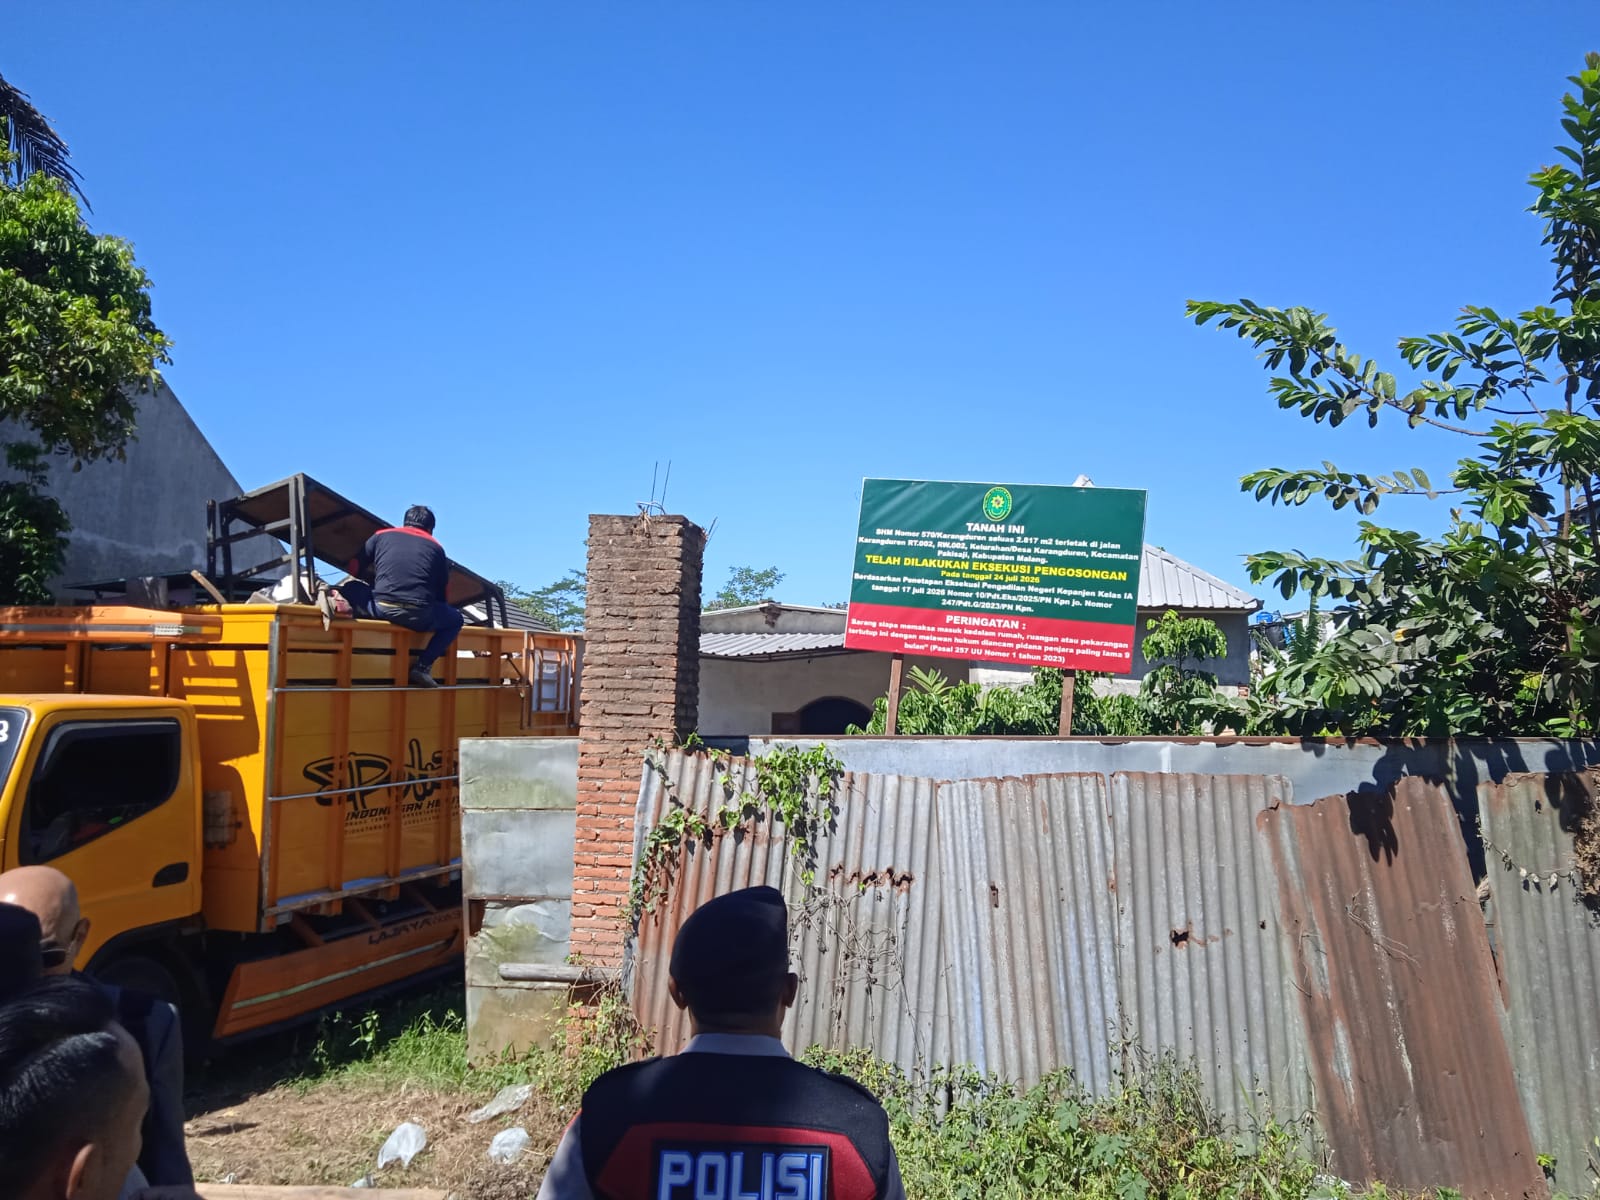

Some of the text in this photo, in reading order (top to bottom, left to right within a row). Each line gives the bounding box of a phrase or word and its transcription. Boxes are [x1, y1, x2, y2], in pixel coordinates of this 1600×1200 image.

[875, 528, 893, 536] SHM
[988, 535, 1014, 543] seluas
[1055, 539, 1087, 547] terletak
[1098, 542, 1121, 550] jalan
[965, 522, 1025, 534] TANAH INI
[858, 537, 906, 546] Karangduren
[907, 540, 935, 548] RT.002,
[970, 543, 1032, 554] Kelurahan/Desa
[1033, 547, 1089, 558] Karangduren,
[1091, 551, 1139, 560] Kecamatan
[971, 551, 1014, 562] Kabupaten
[1016, 555, 1048, 564] Malang.
[865, 554, 1127, 581] TELAH DILAKUKAN EKSEKUSI PENGOSONGAN
[941, 570, 961, 578] Pada
[962, 571, 992, 580] tanggal
[1005, 575, 1018, 583] juli
[854, 572, 1134, 600] Berdasarkan Penetapan Eksekusi Pengadilan Negeri Kepanjen Kelas IA
[871, 584, 900, 593] tanggal
[912, 586, 925, 595] juli
[947, 590, 973, 598] Nomor
[1053, 598, 1071, 606] Kpn
[1084, 600, 1113, 609] Nomor
[1015, 603, 1034, 613] Kpn.
[945, 615, 1019, 629] PERINGATAN
[848, 627, 878, 637] tertutup
[879, 629, 889, 637] ini
[890, 631, 917, 641] dengan
[919, 634, 952, 643] melawan
[954, 636, 980, 645] hukum
[981, 638, 1014, 648] diancam
[1015, 642, 1042, 651] pidana
[1044, 644, 1074, 654] penjara
[1075, 647, 1100, 657] paling
[1102, 649, 1123, 658] lama
[878, 621, 898, 630] siapa
[900, 623, 935, 632] memaksa
[937, 625, 962, 634] masuk
[963, 628, 996, 637] kedalam
[998, 632, 1025, 640] rumah,
[1026, 634, 1059, 644] ruangan
[1060, 636, 1079, 644] atau
[1080, 638, 1129, 649] pekarangan
[930, 644, 953, 653] (Pasal
[984, 649, 1010, 658] Nomor
[1012, 651, 1017, 659] 1
[1018, 651, 1041, 661] tahun
[1043, 654, 1066, 663] 2023)
[656, 1149, 823, 1200] POLISI
